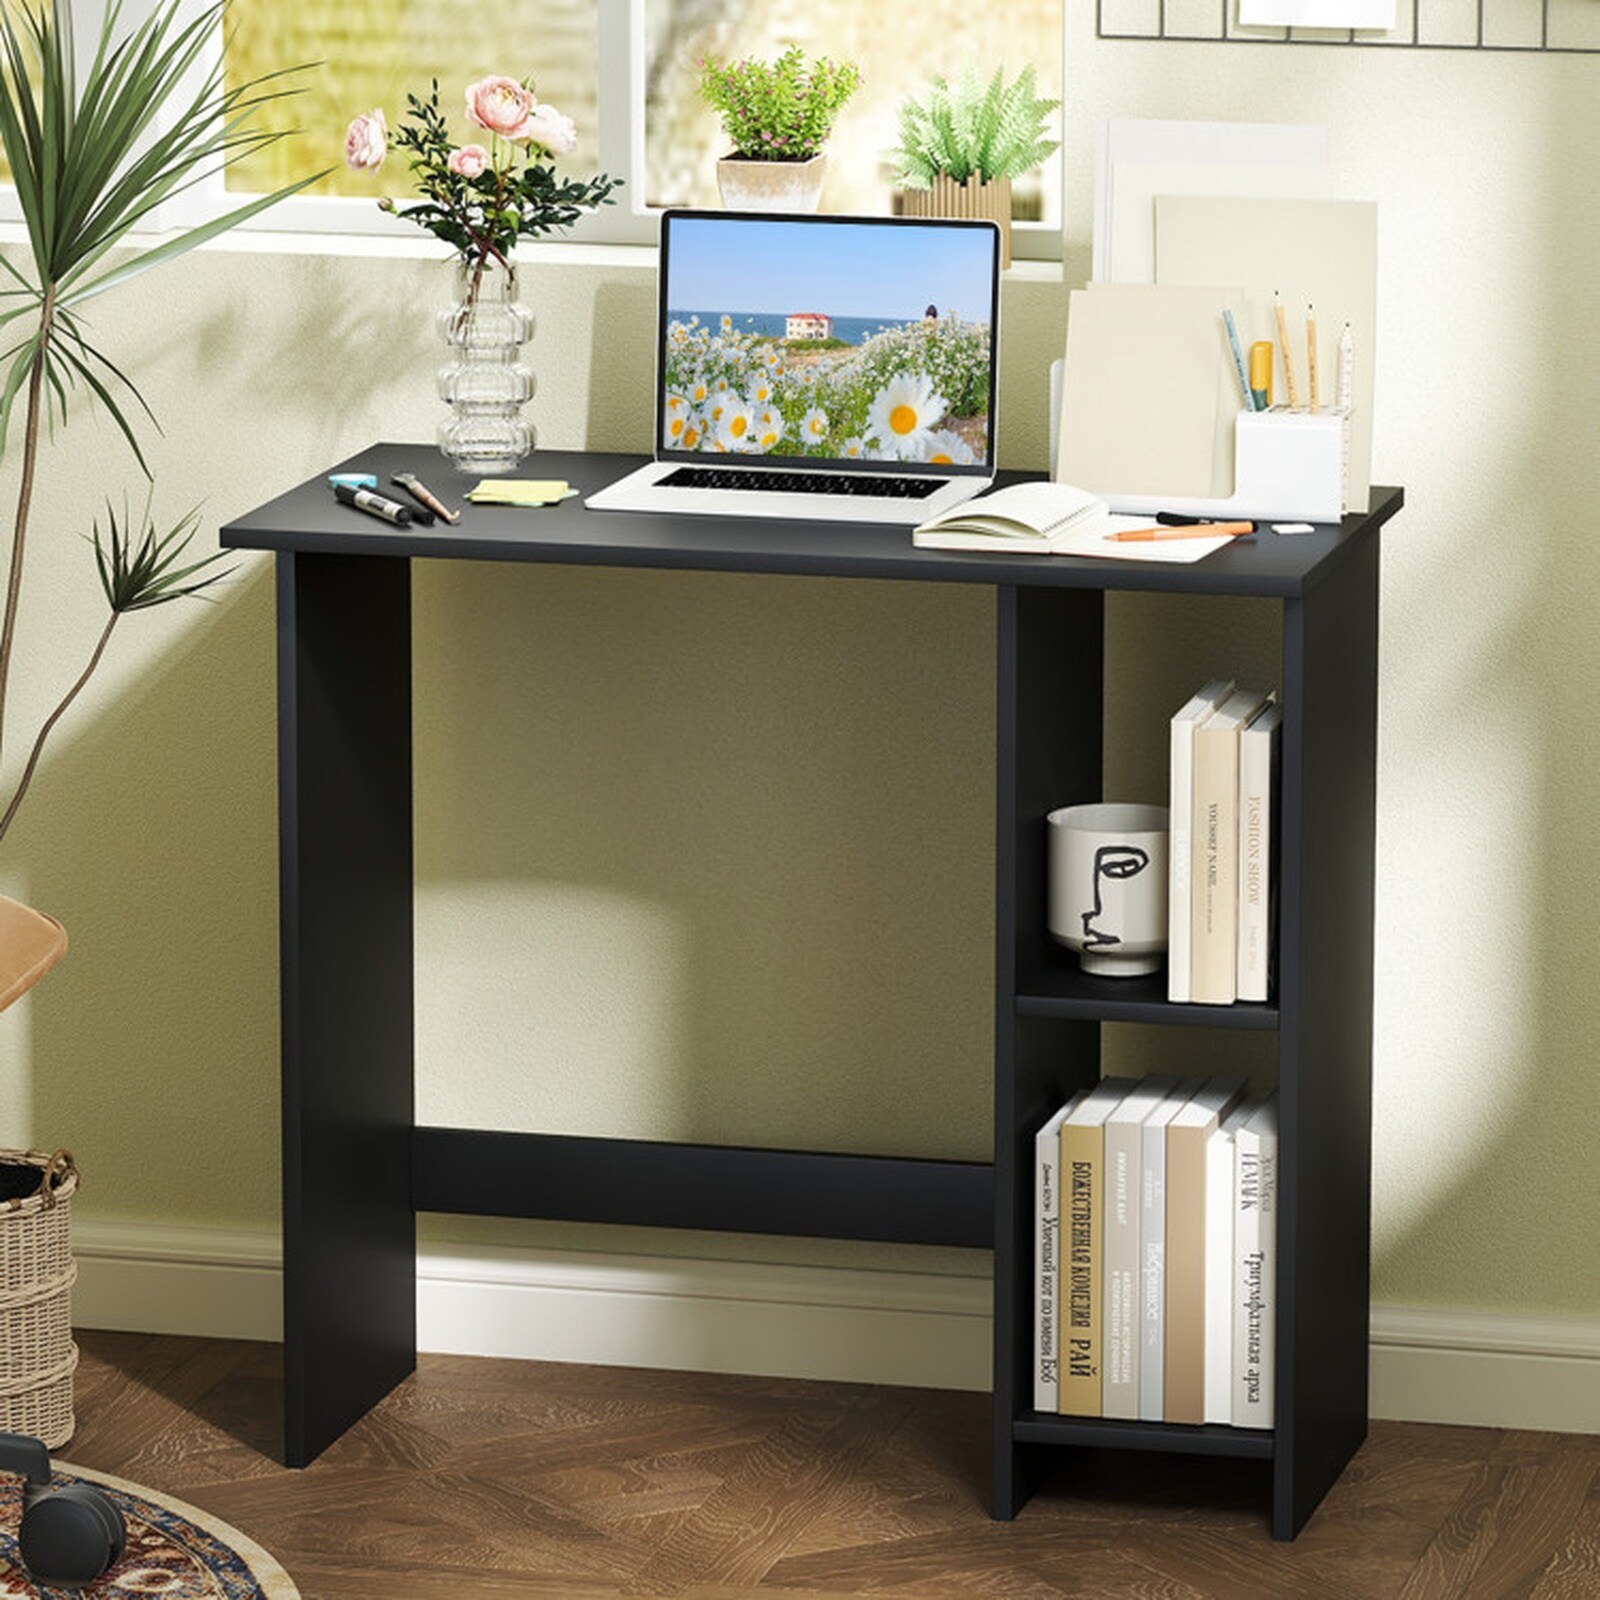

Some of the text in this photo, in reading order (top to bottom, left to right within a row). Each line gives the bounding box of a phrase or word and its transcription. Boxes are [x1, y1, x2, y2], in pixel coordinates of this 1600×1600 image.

[1248, 797, 1261, 905] FASHION SHOW
[1041, 1275, 1053, 1296] кот
[1070, 1161, 1098, 1378] БОЖЕСТВЕННАЯ КОМЕДИЯ РАЙ
[1040, 1359, 1058, 1384] Боб
[1243, 1251, 1265, 1404] Триумфальная арка
